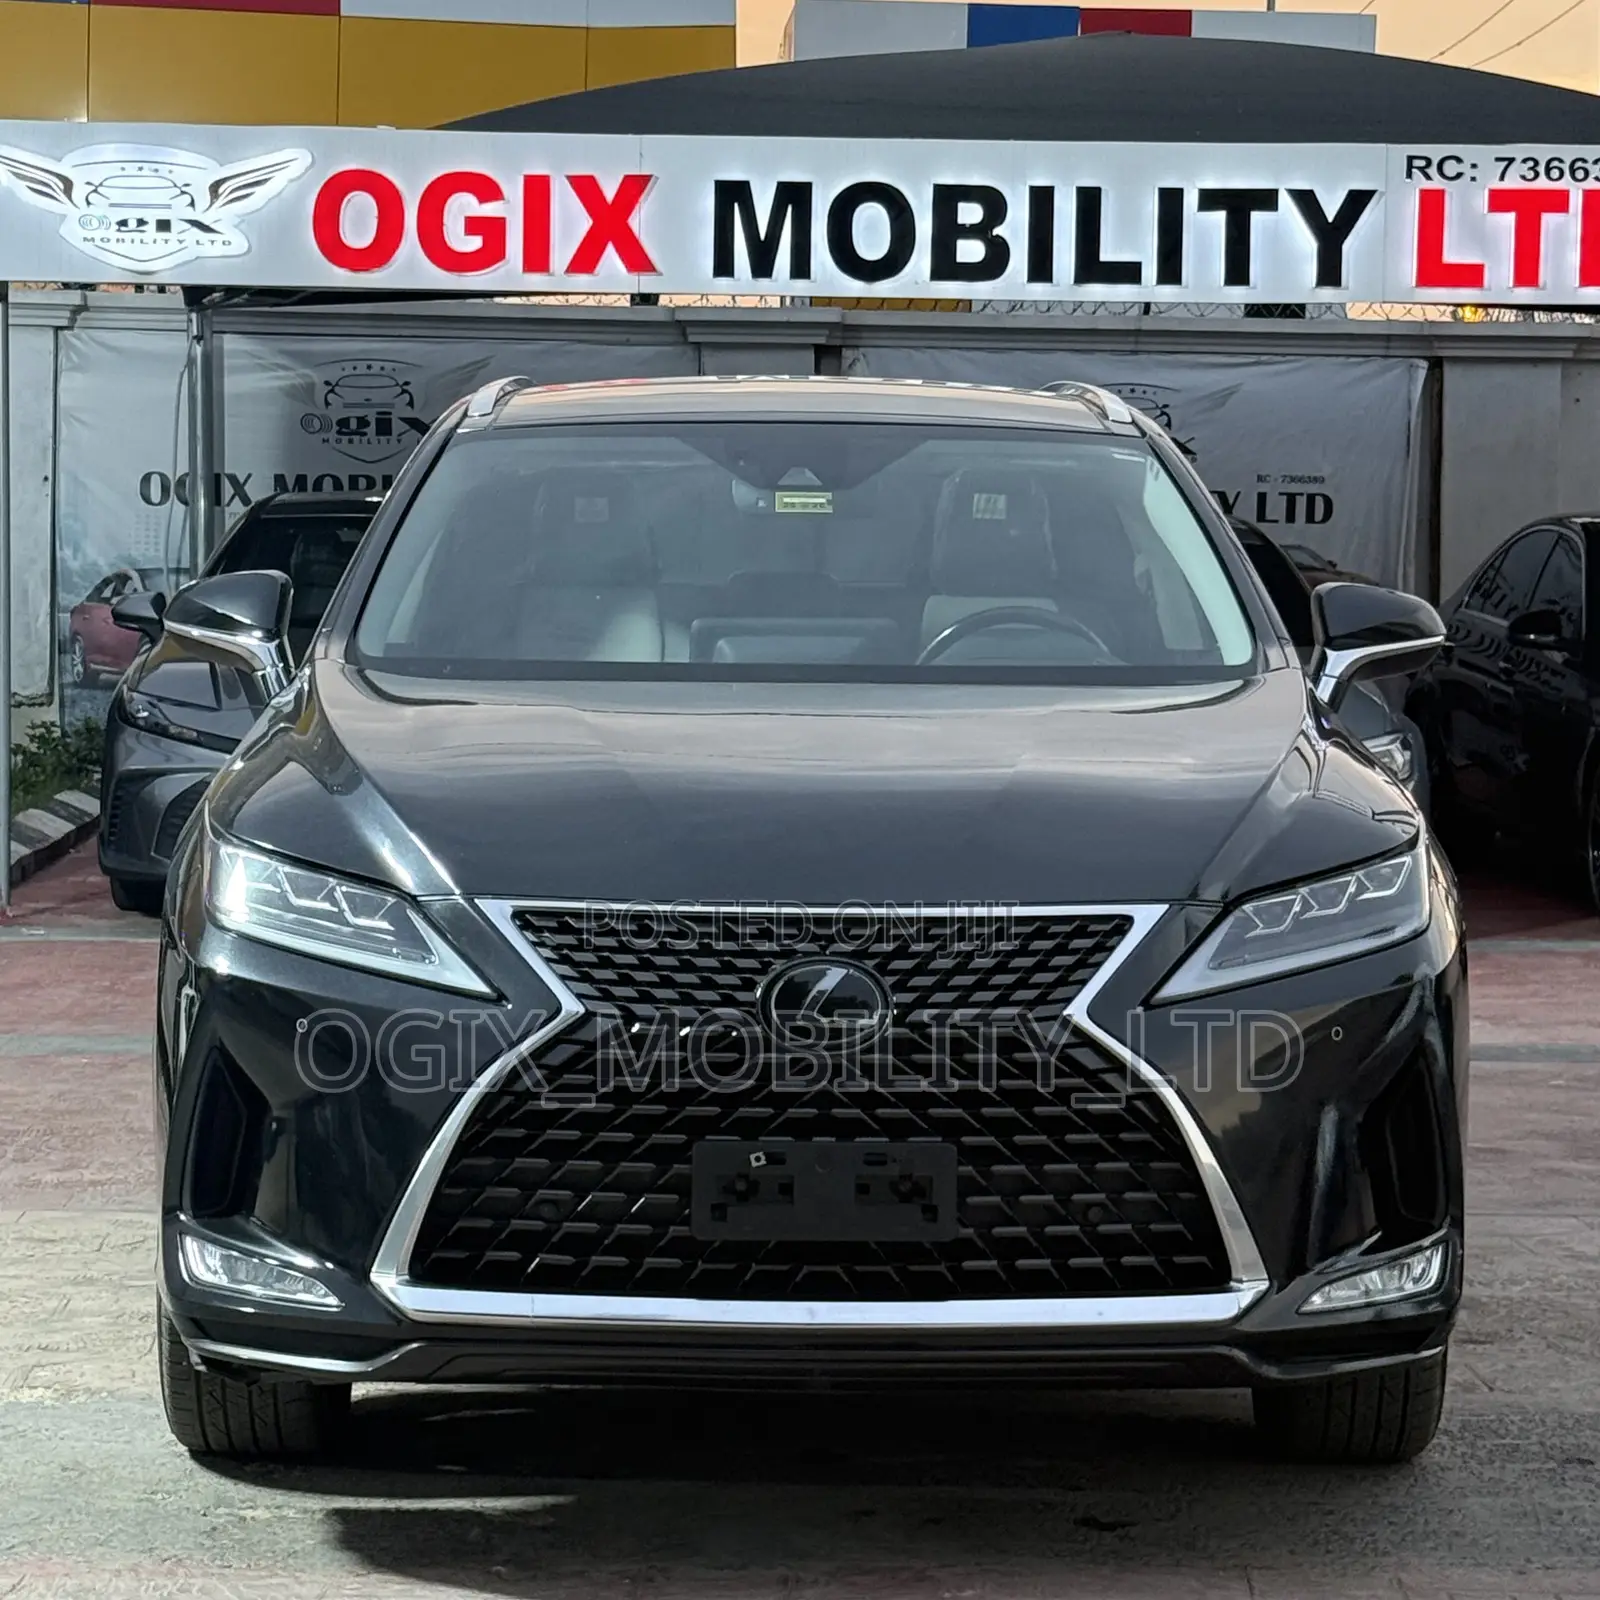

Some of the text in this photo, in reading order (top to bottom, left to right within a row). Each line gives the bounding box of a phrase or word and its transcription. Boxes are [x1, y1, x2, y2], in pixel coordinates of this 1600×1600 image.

[1405, 155, 1479, 182] RC:
[312, 168, 1600, 288] OGIX MOBILITY LT
[82, 236, 233, 247] MOBILITY LTD
[321, 437, 403, 445] MOBILITY
[1256, 474, 1271, 483] RC
[1255, 491, 1334, 525] LTD
